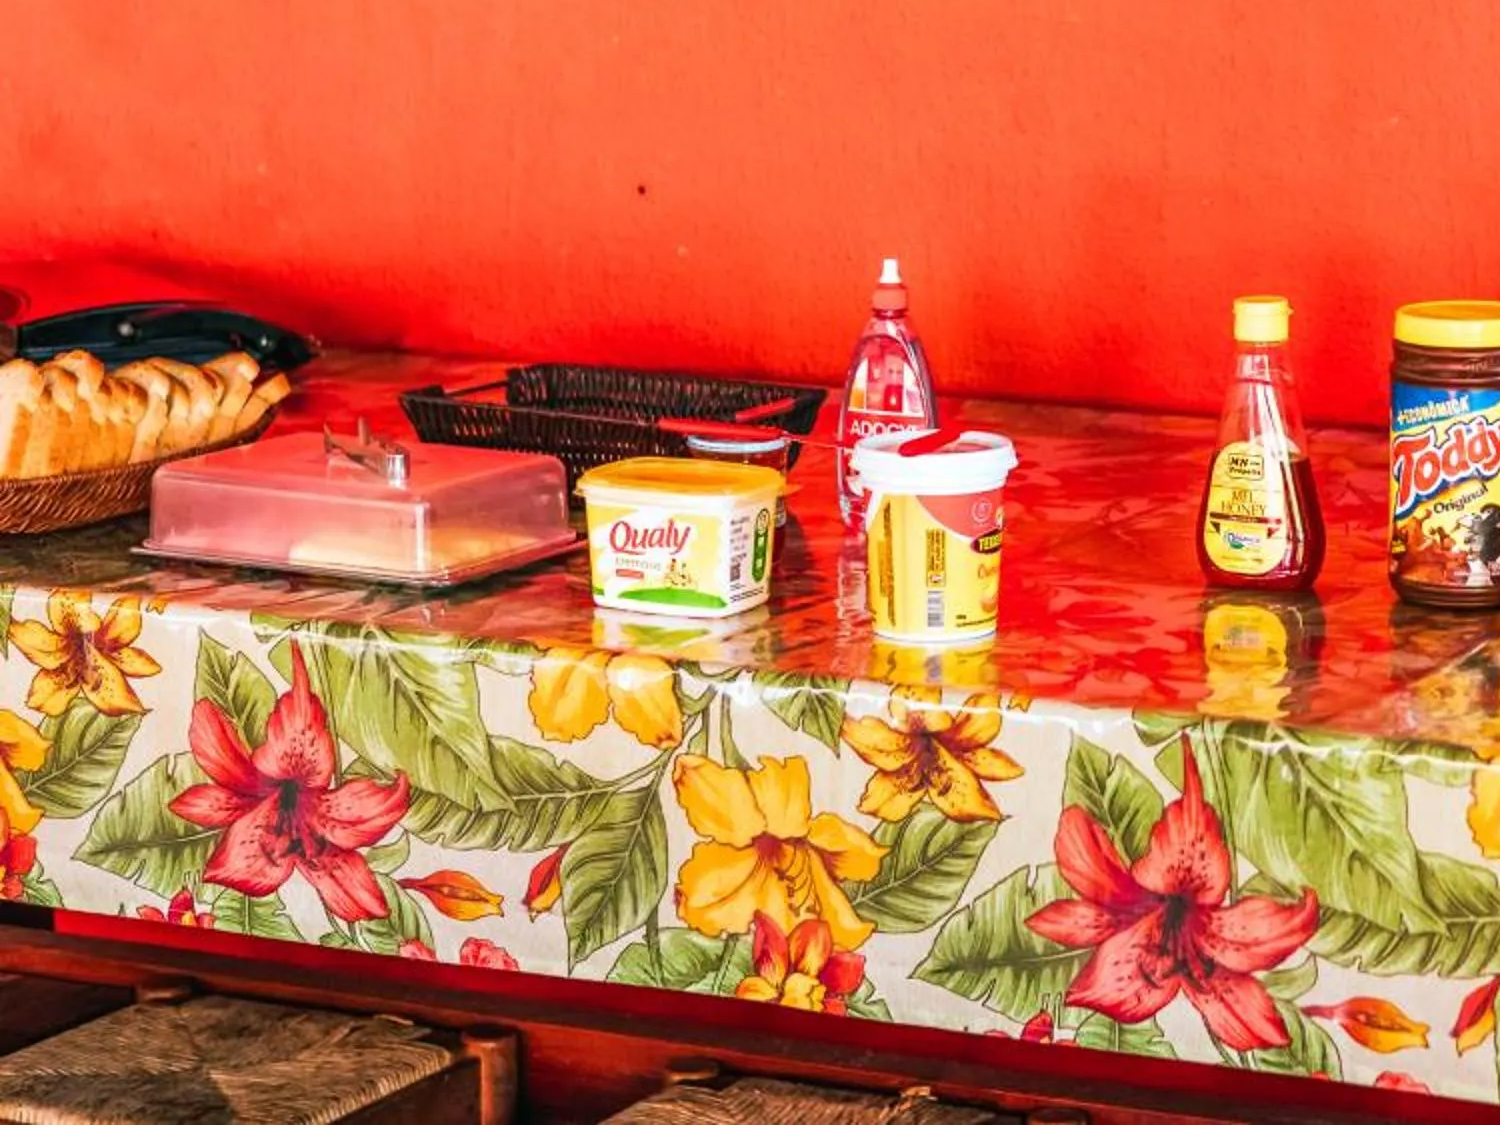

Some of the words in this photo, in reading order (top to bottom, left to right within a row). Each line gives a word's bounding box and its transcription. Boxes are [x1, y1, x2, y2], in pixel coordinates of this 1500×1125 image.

[1221, 500, 1267, 516] HONEY
[1433, 481, 1489, 514] Original
[609, 518, 691, 556] Qualy
